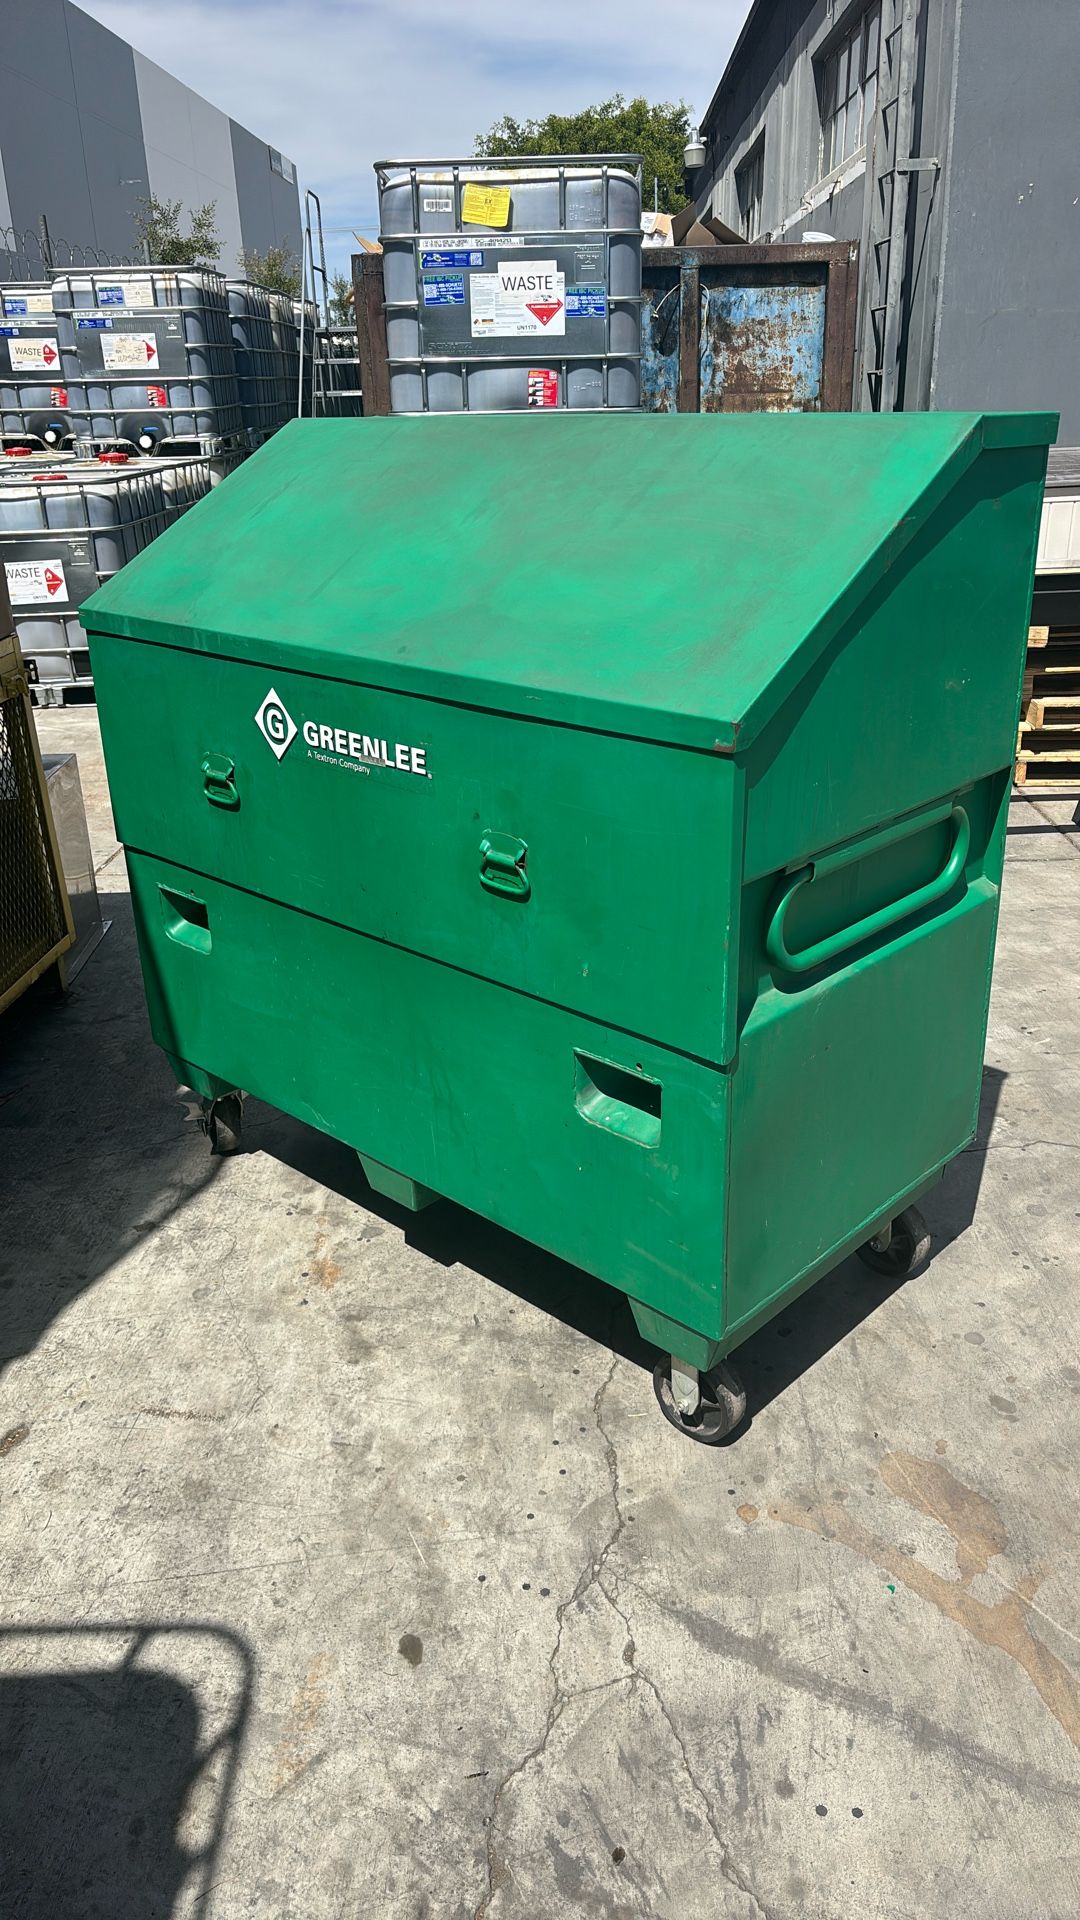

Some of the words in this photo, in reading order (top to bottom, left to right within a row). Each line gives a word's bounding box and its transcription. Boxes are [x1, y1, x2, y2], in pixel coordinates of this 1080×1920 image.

[501, 275, 553, 291] WASTE
[14, 346, 42, 357] WASTE
[303, 720, 427, 775] GREENLEE
[307, 749, 313, 758] A
[314, 751, 338, 765] Textron
[339, 758, 371, 775] Company
